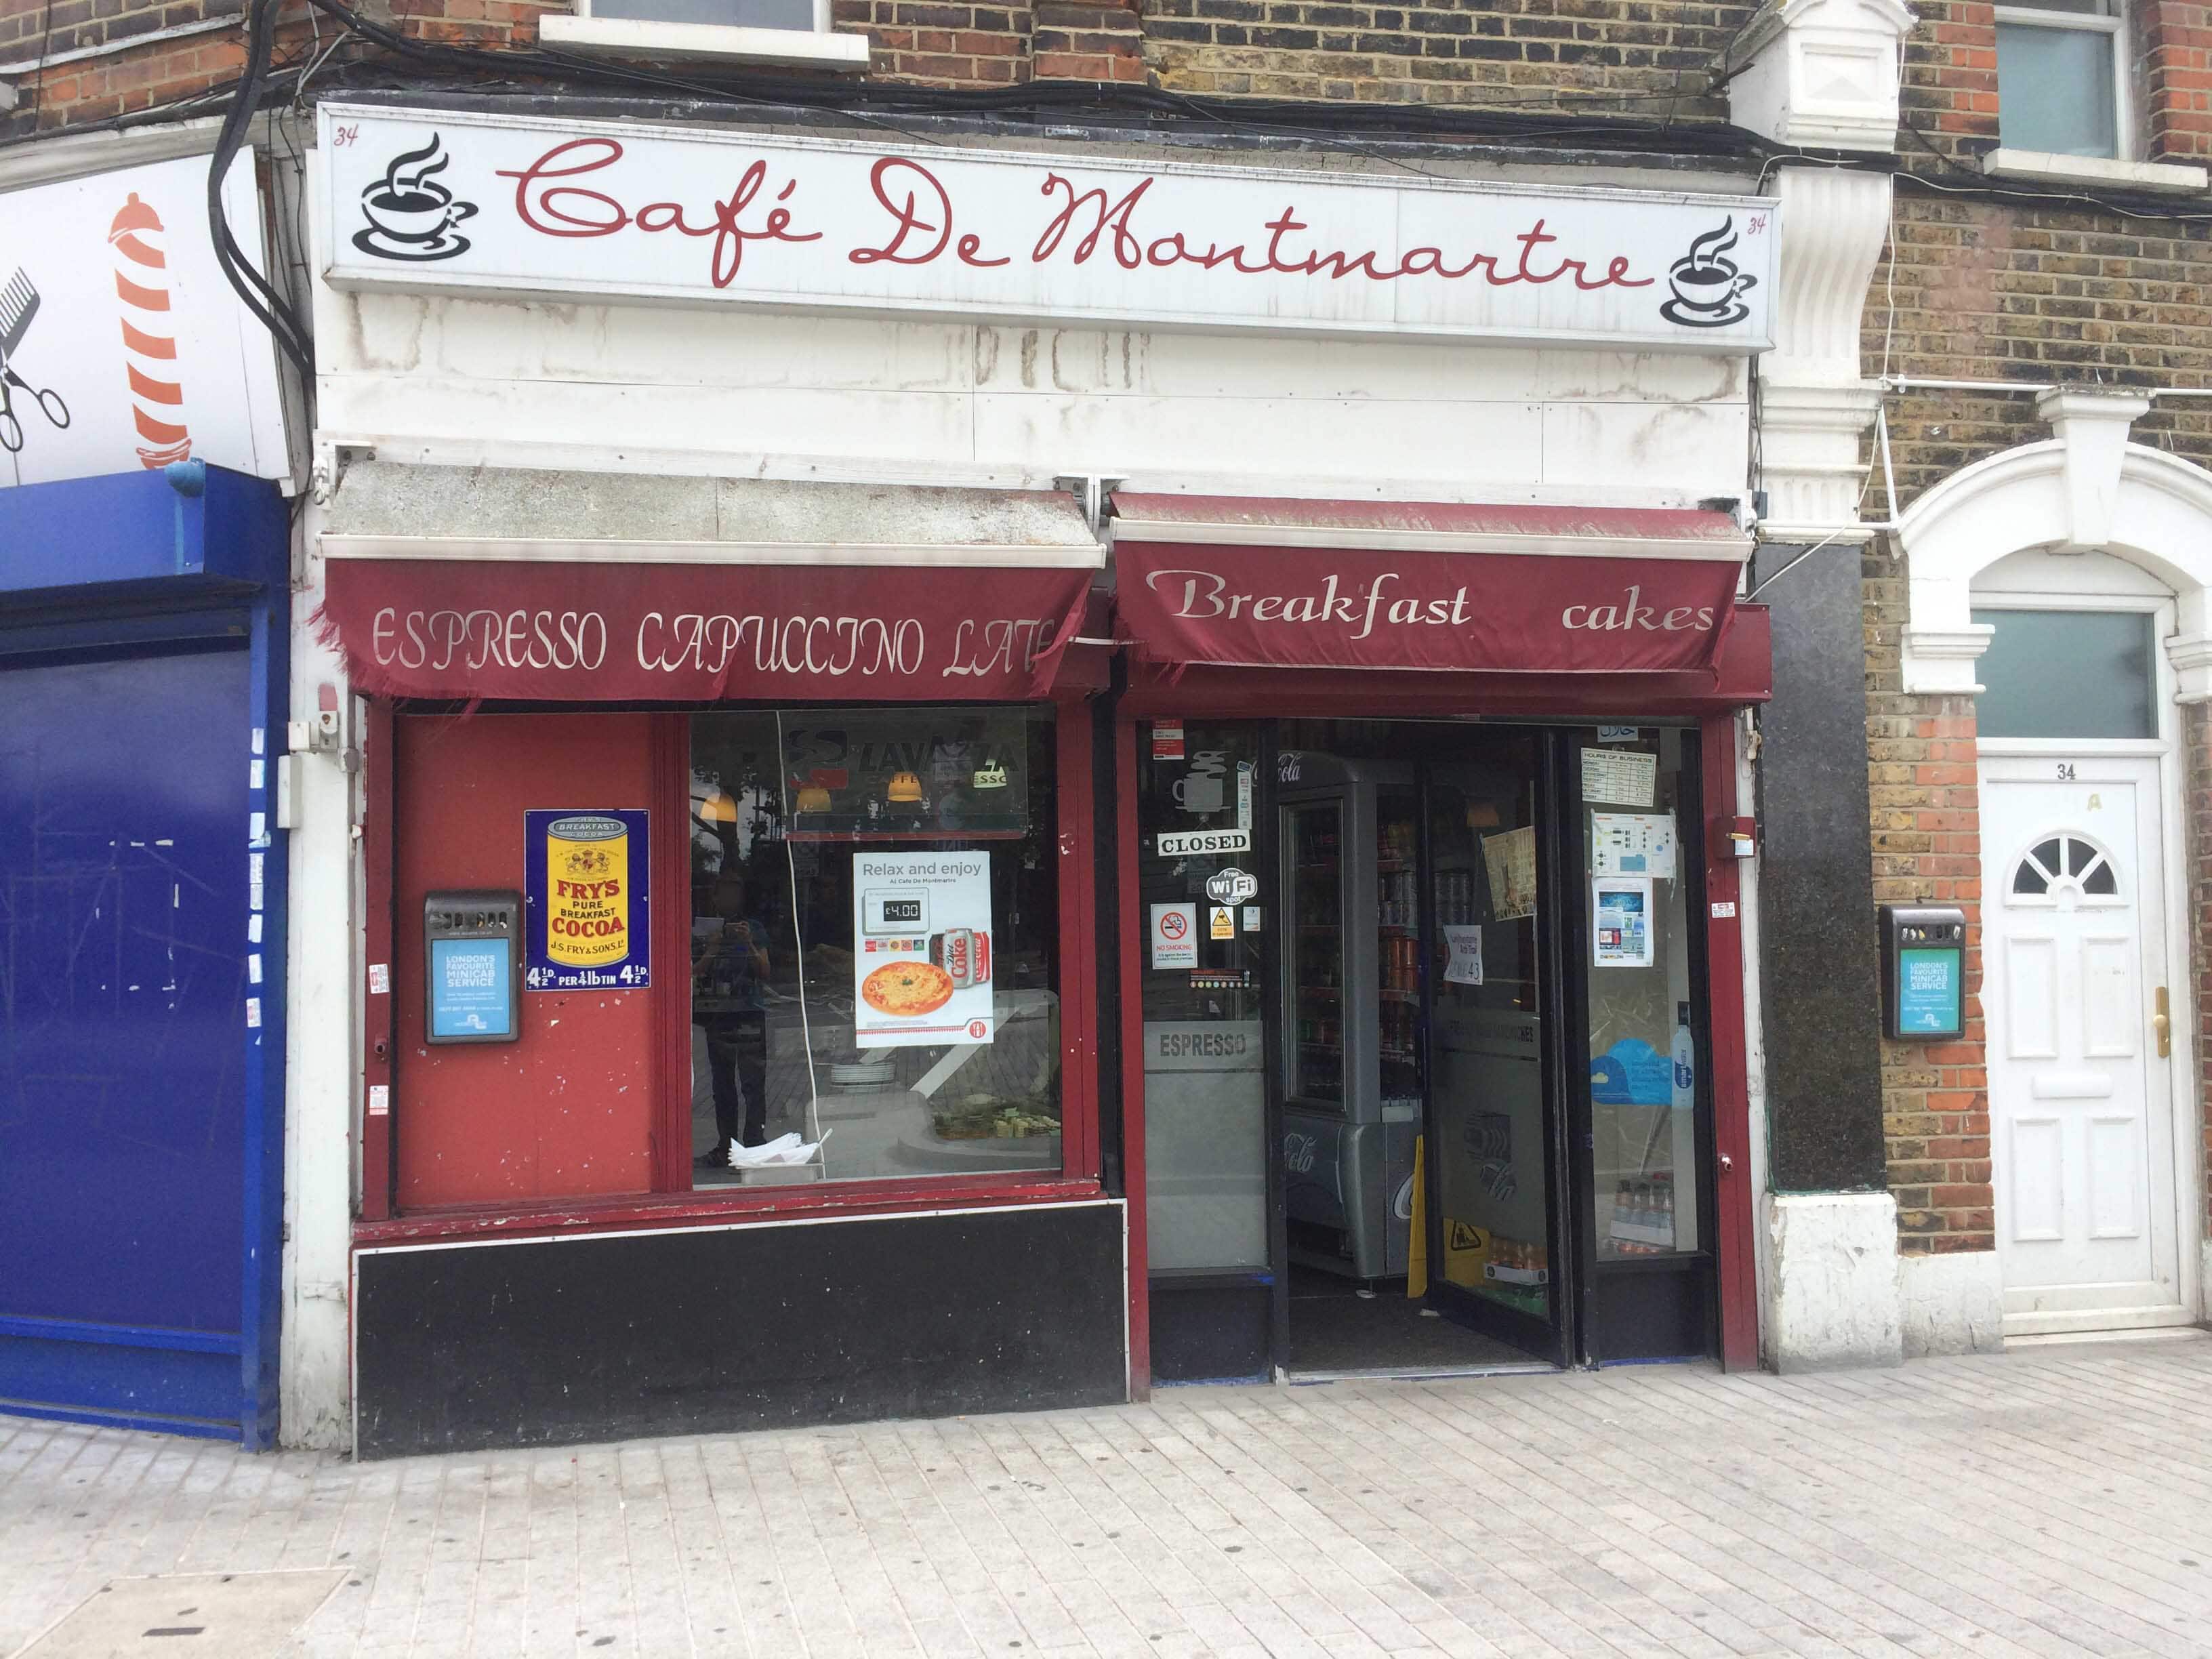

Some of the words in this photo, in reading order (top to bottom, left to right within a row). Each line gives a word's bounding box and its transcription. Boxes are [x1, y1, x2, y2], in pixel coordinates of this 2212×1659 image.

[334, 123, 359, 147] 34
[495, 137, 823, 289] Café
[848, 157, 1012, 267] De
[1031, 172, 1655, 291] Montmartre
[1747, 214, 1767, 234] 34
[1145, 569, 1472, 640] Breakfast
[1562, 585, 1714, 633] cakes
[372, 607, 607, 670] ESPRESSO
[636, 611, 924, 676] CAPUCCINO
[2057, 764, 2076, 780] 34
[2087, 794, 2102, 811] A
[1162, 835, 1246, 853] CLOSED
[863, 863, 904, 876] Relax
[909, 862, 936, 874] and
[941, 861, 981, 876] enjoy
[557, 879, 619, 899] FRY'S
[560, 907, 615, 919] BREAKFAST
[573, 901, 602, 909] PURE
[886, 905, 918, 917] £4.00
[552, 916, 625, 937] COCOA
[446, 954, 495, 962] LONDON'S
[951, 937, 968, 978] Coke
[446, 962, 495, 970] FAVOURITE
[446, 970, 495, 979] MINICAB
[558, 976, 577, 985] PER
[600, 975, 616, 985] TIN
[1910, 975, 1948, 983] MINICAB
[447, 979, 494, 987] SERVICE
[1910, 982, 1947, 990] SERVICE
[1160, 1033, 1246, 1057] ESPRESSO
